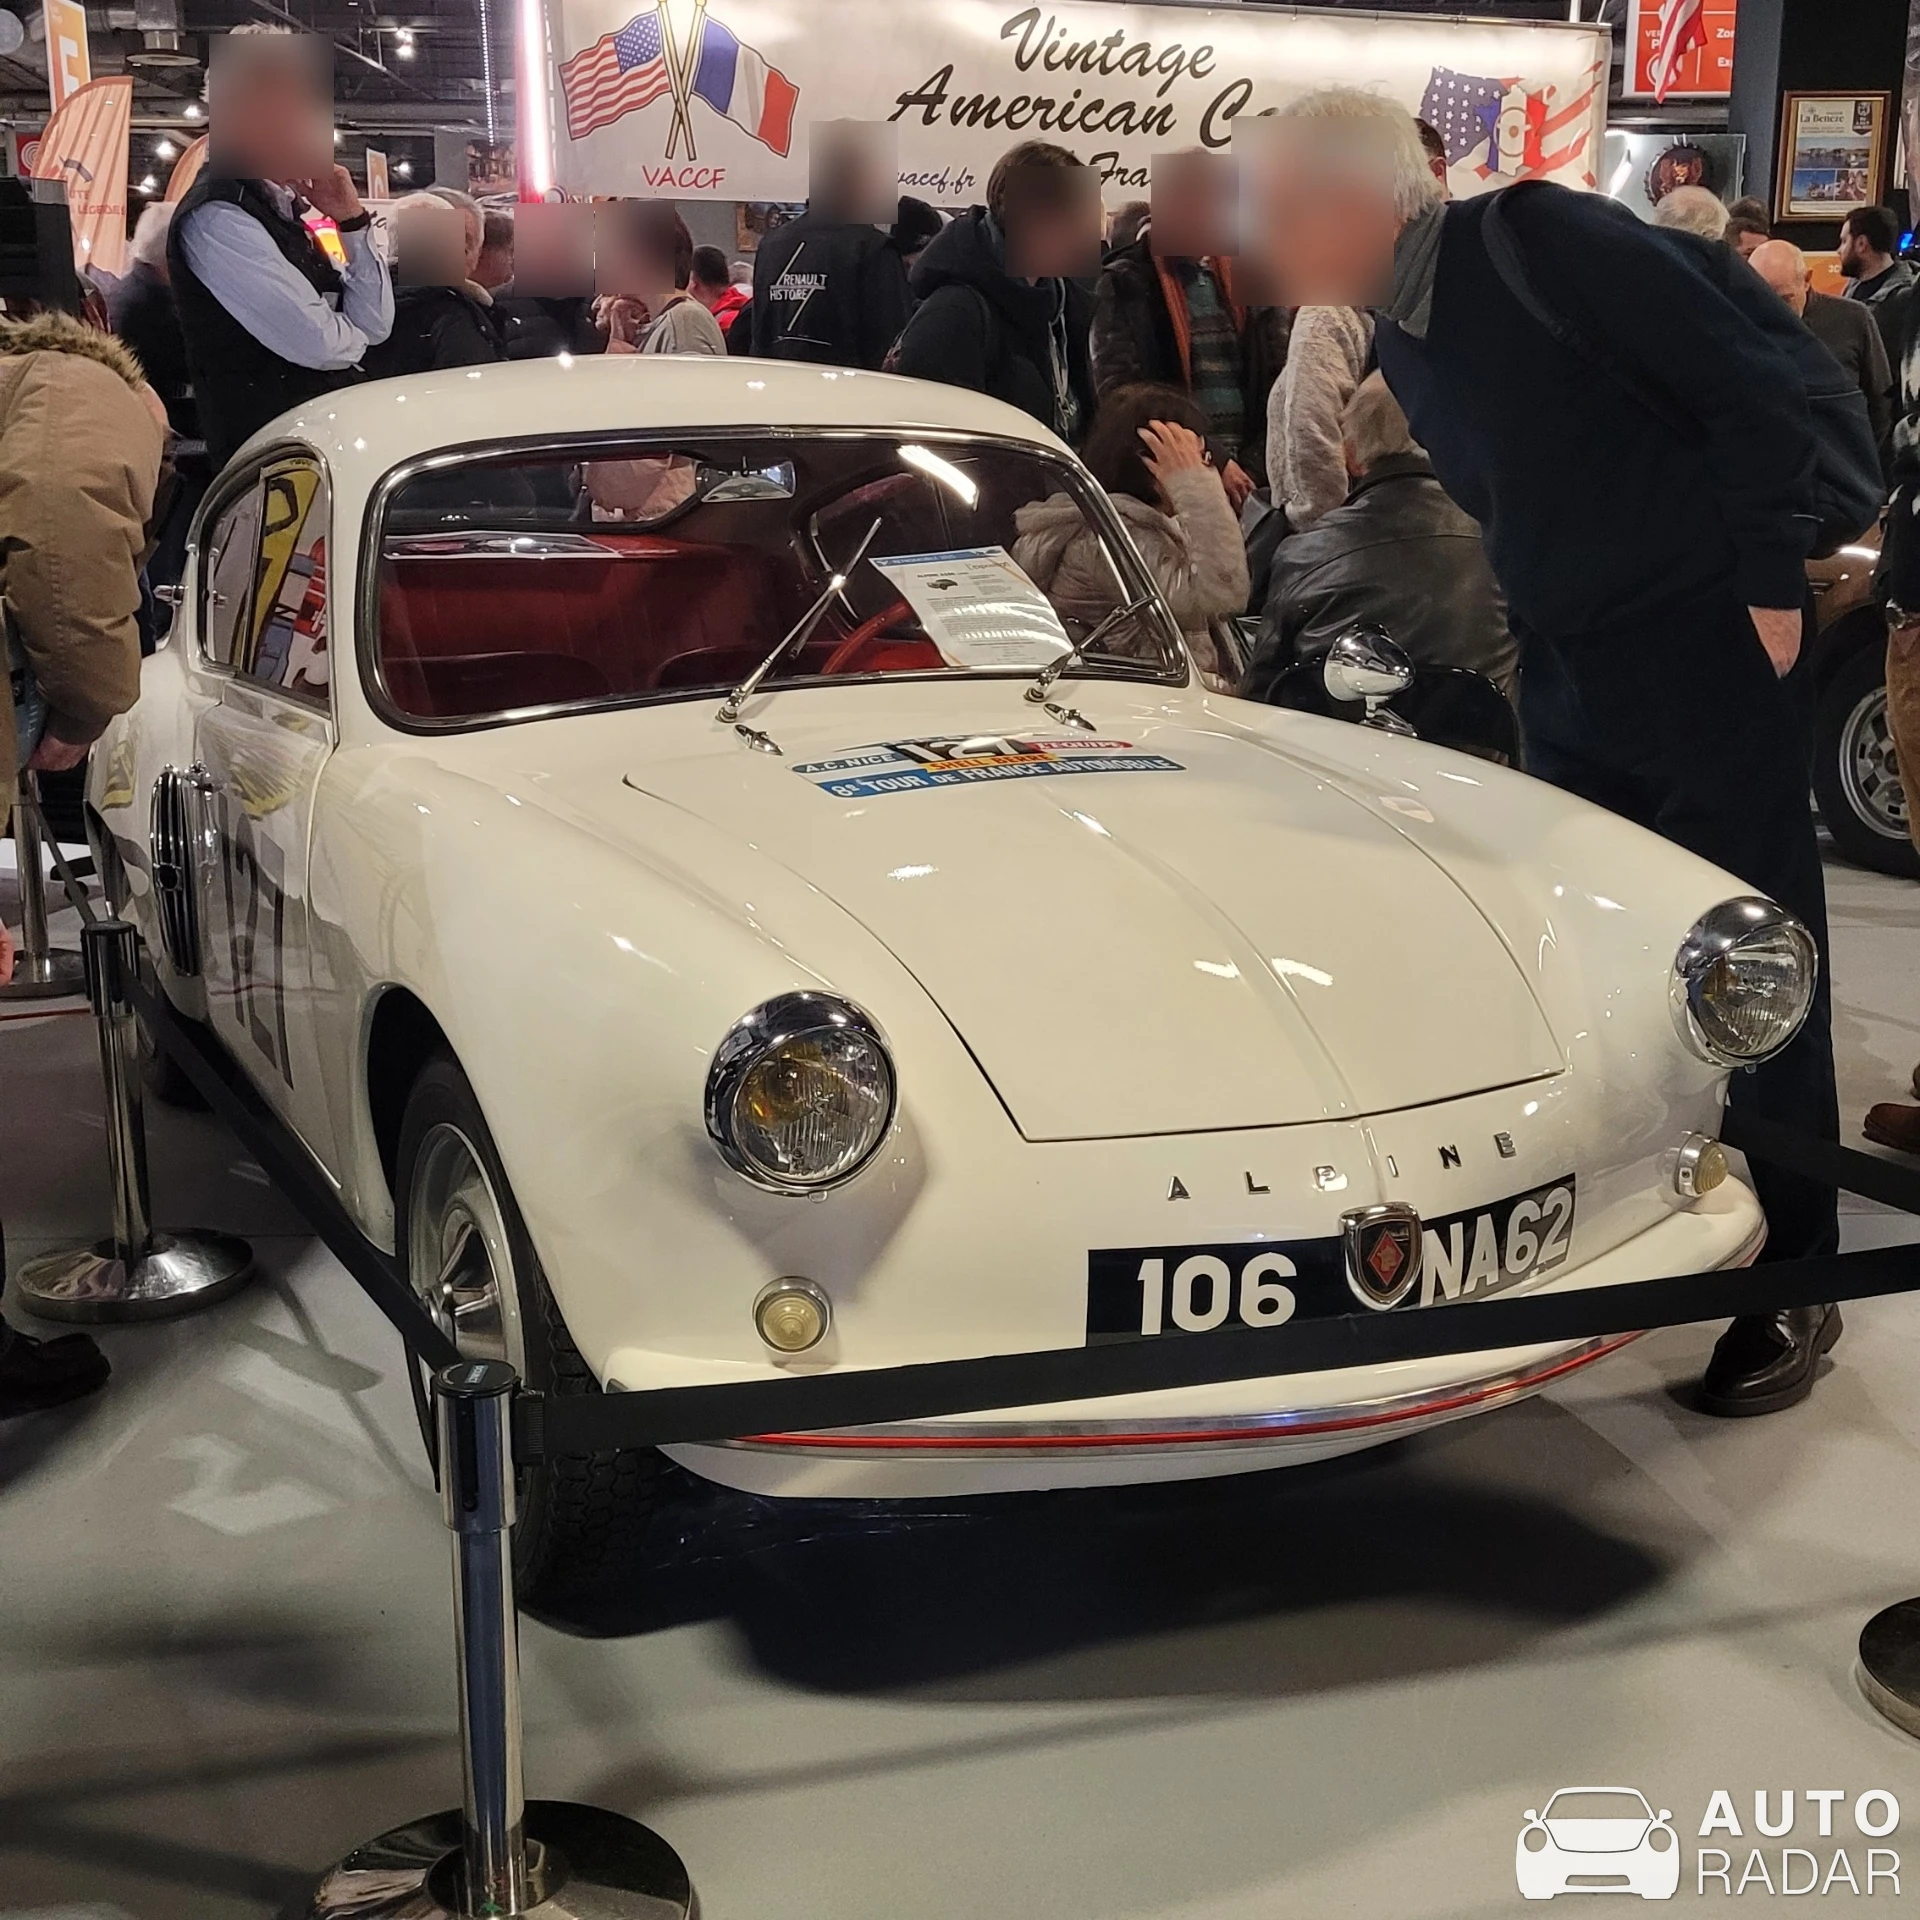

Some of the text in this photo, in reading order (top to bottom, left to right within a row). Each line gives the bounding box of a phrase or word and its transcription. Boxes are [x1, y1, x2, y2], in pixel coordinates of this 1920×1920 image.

[1000, 7, 1217, 98] Vintage
[887, 64, 1177, 135] American
[642, 151, 1151, 195] VACCF vaccf.fr Fra
[783, 273, 828, 287] RENAULT
[858, 774, 930, 792] TOUR
[929, 773, 961, 785] DE
[957, 763, 1050, 780] FRANCE
[1049, 758, 1179, 773] AUTOMOBILE
[929, 753, 1054, 770] SHELL BERRE
[1167, 1130, 1517, 1201] ALPINE
[1137, 1252, 1298, 1336] 106
